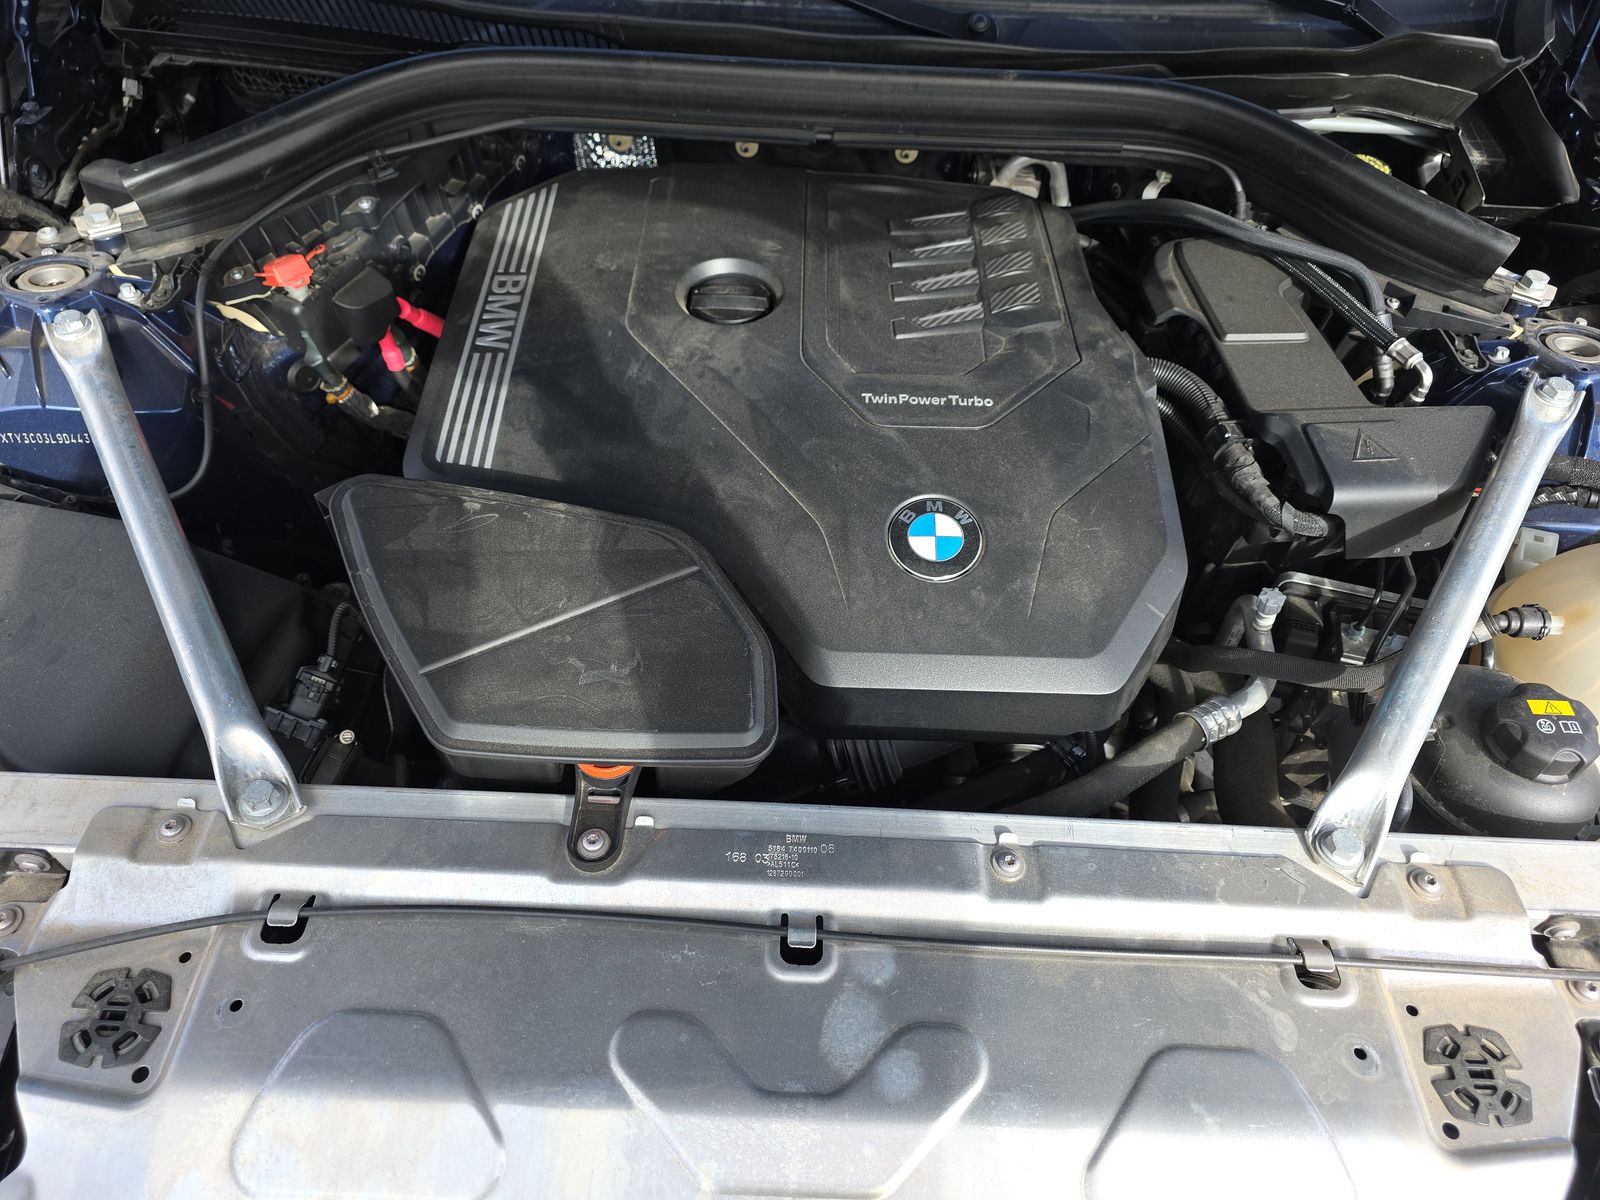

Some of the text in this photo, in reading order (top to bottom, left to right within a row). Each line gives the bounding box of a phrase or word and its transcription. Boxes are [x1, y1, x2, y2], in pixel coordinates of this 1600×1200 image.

[475, 274, 527, 349] BMW
[948, 395, 994, 407] Turbo
[899, 500, 972, 525] BMW
[785, 834, 808, 843] BMW
[820, 843, 835, 854] 06
[725, 851, 770, 864] 168 03
